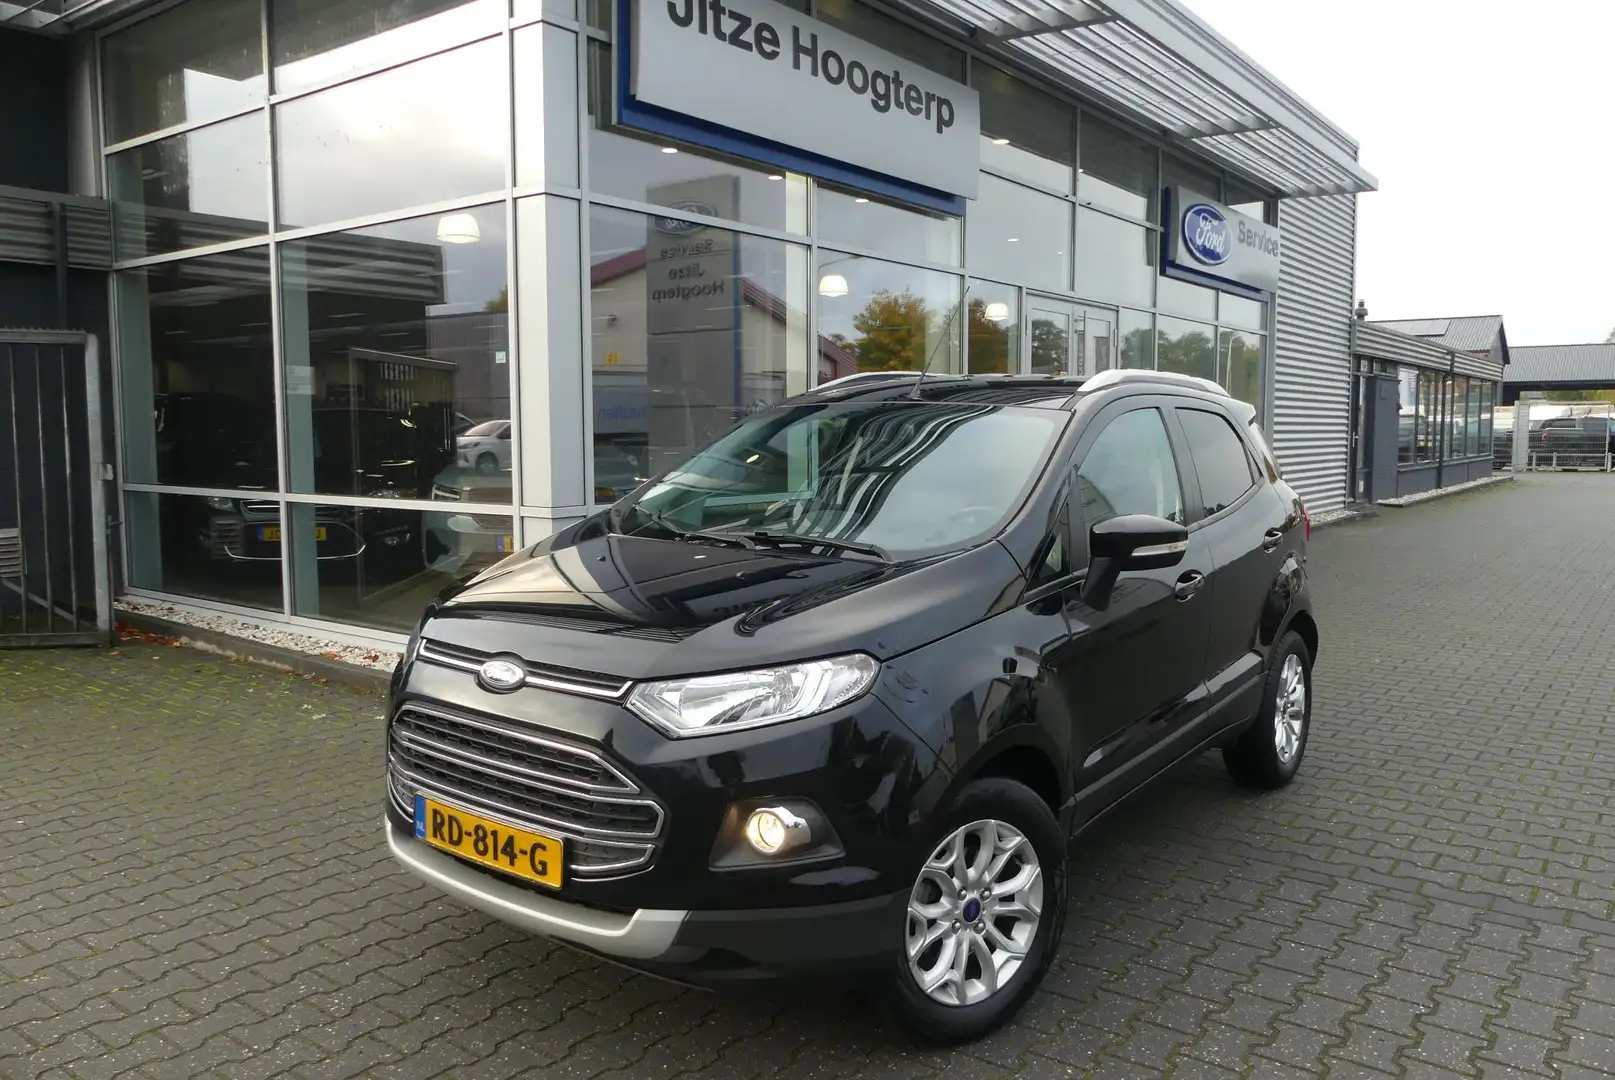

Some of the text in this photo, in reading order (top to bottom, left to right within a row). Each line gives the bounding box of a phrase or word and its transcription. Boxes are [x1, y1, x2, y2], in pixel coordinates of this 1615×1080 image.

[791, 25, 956, 134] Hoogterp
[1195, 212, 1226, 254] Ford
[1237, 219, 1280, 258] Service
[431, 807, 549, 878] RD-814-G
